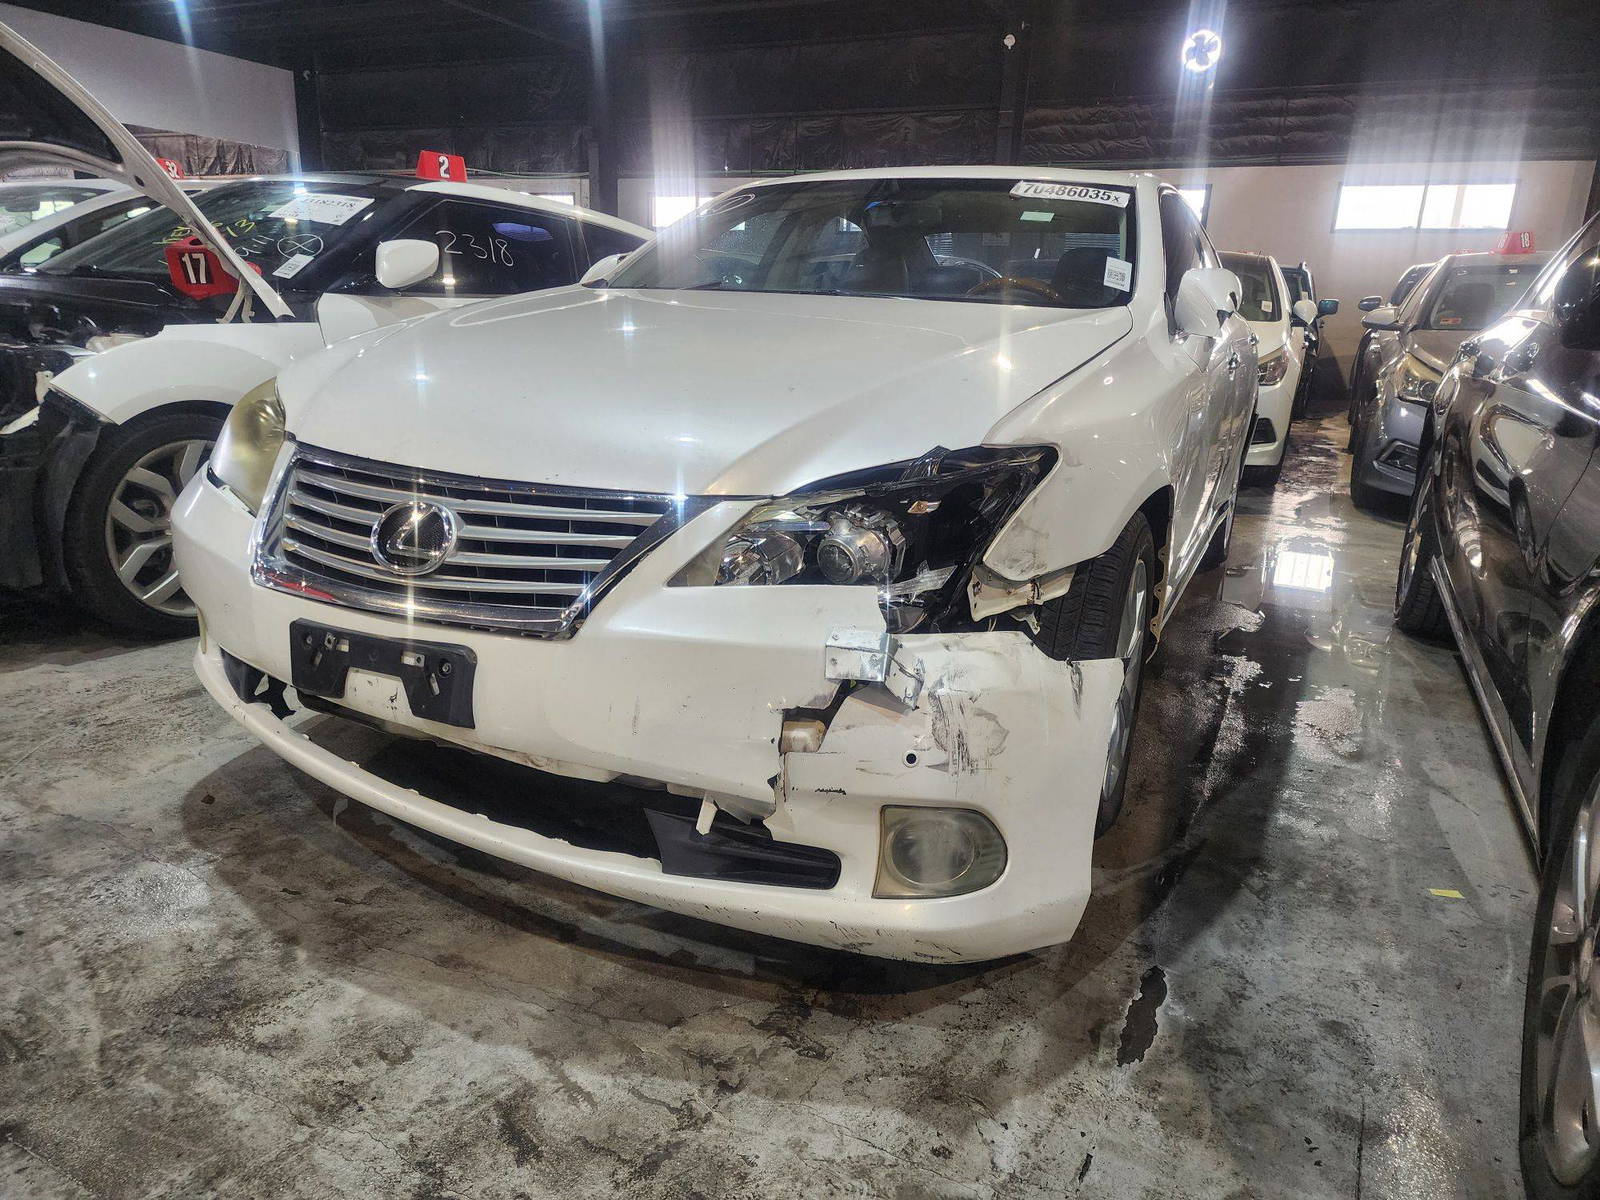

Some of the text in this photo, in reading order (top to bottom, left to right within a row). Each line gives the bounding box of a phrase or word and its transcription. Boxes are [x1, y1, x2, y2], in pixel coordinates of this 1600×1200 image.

[439, 155, 450, 179] 2
[435, 230, 514, 267] 2318
[1520, 231, 1531, 249] 18
[181, 252, 207, 284] 17
